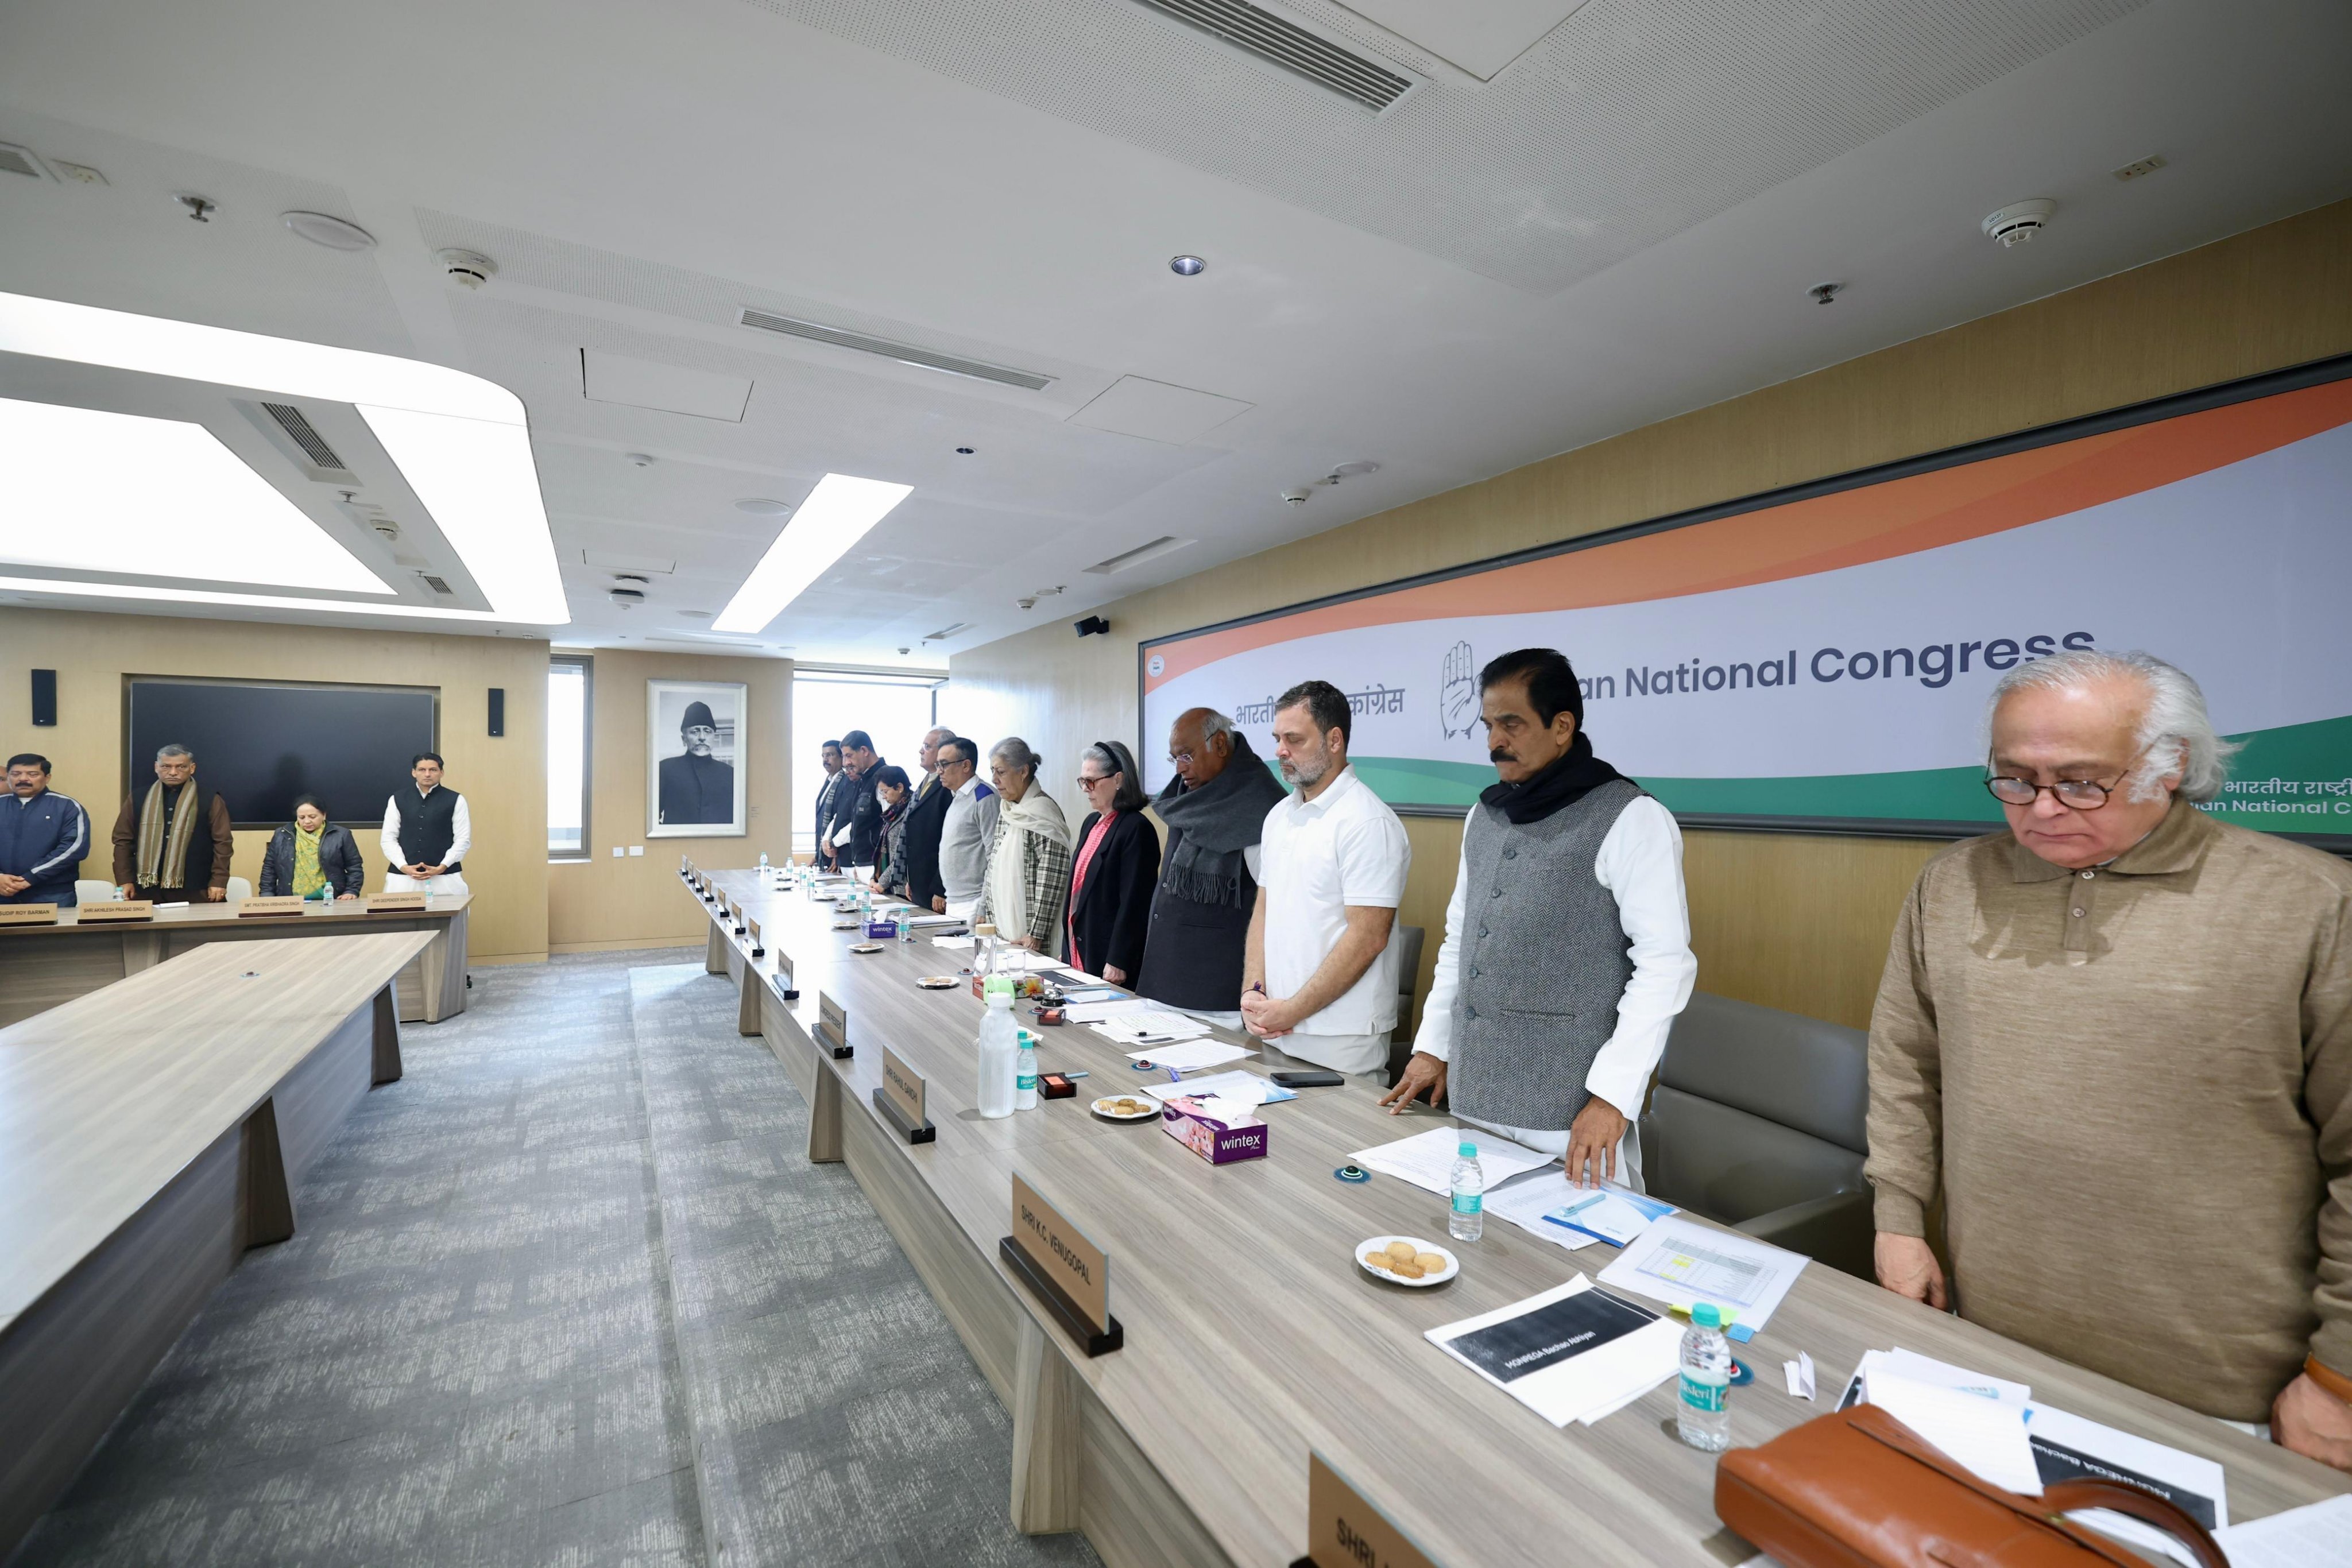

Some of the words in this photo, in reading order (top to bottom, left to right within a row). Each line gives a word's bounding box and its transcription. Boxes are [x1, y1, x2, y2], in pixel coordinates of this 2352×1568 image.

[1626, 649, 1796, 697] National
[1236, 695, 1276, 725] भारती
[2225, 777, 2300, 794] भारतीय
[2232, 800, 2327, 814] National
[1221, 1135, 1260, 1150] wintex
[1022, 1205, 1035, 1230] SHRI
[1036, 1219, 1049, 1244] K.C.
[1049, 1232, 1091, 1286] VENUGOPAL
